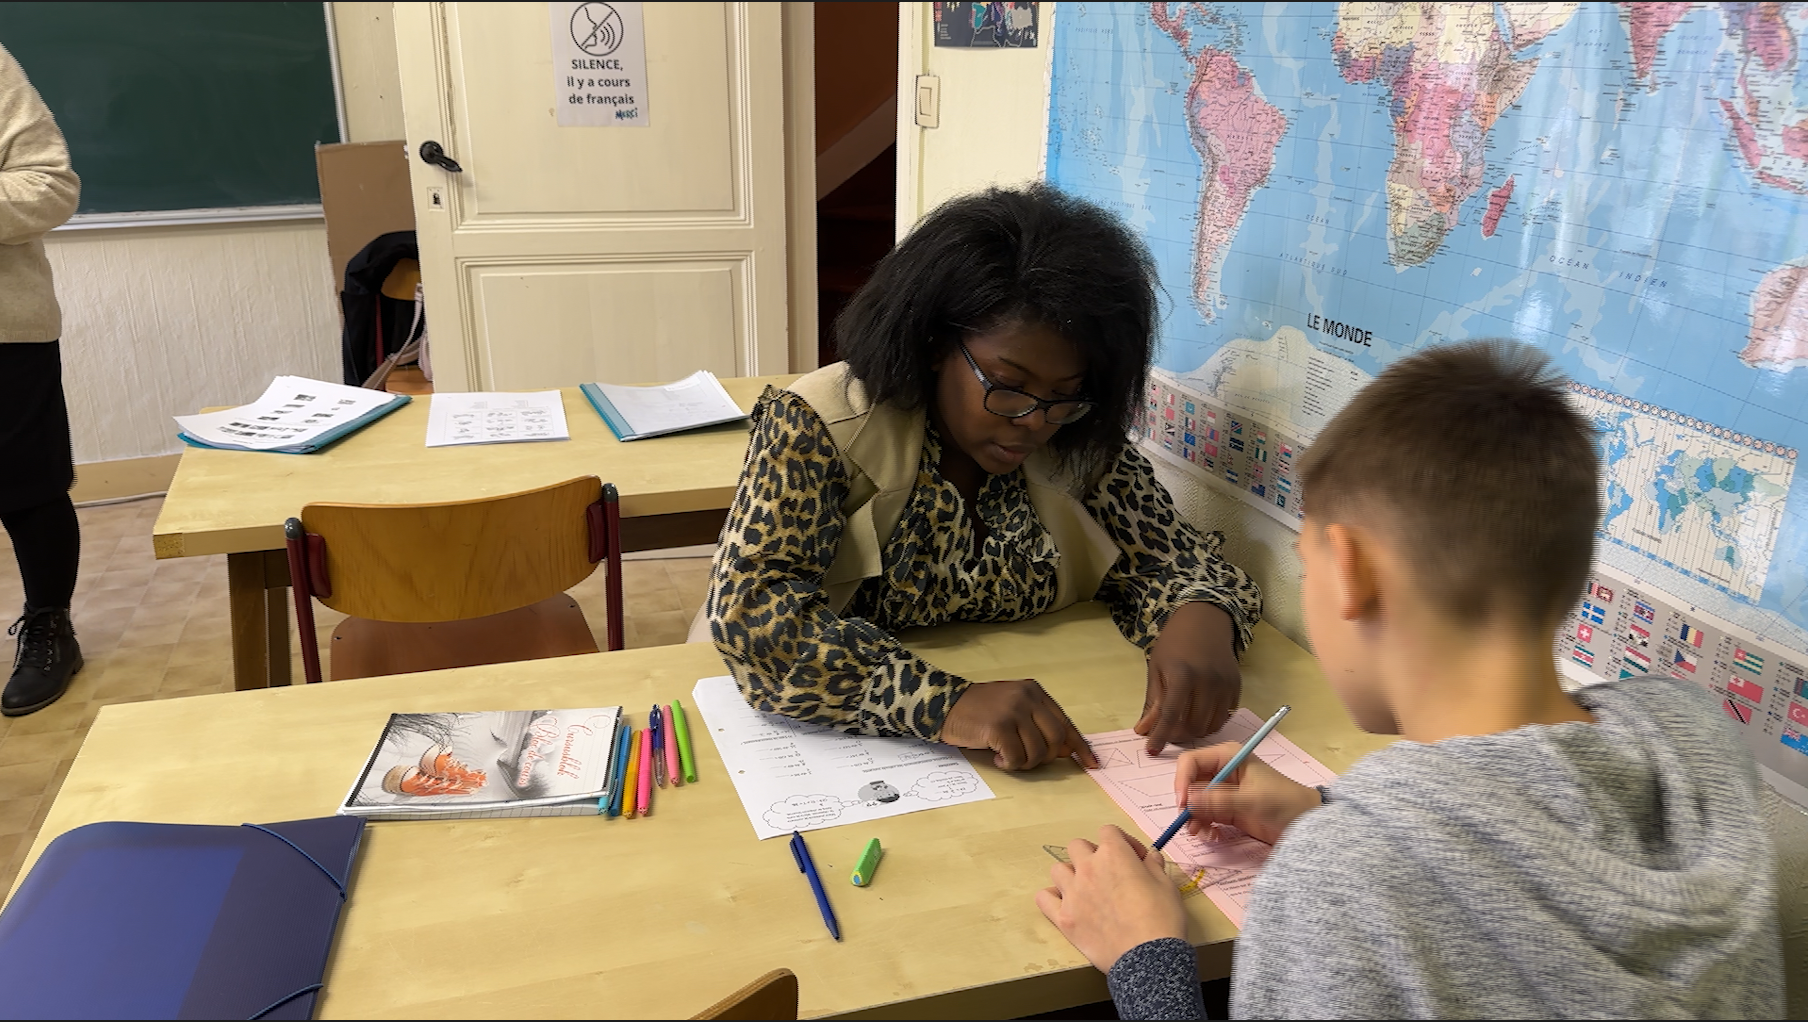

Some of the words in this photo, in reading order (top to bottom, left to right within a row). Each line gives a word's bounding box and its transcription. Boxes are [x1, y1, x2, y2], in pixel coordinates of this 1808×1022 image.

[571, 59, 623, 71] SILENCE,
[566, 75, 575, 87] il
[577, 78, 585, 90] y
[587, 78, 595, 87] a
[597, 78, 631, 87] cours
[568, 93, 584, 104] de
[586, 93, 635, 107] français
[1307, 312, 1321, 331] LE
[1322, 318, 1373, 347] MONDE
[528, 716, 561, 748] Bloc
[526, 750, 546, 761] de
[556, 714, 612, 780] Cursusblok
[517, 761, 532, 788] cours
